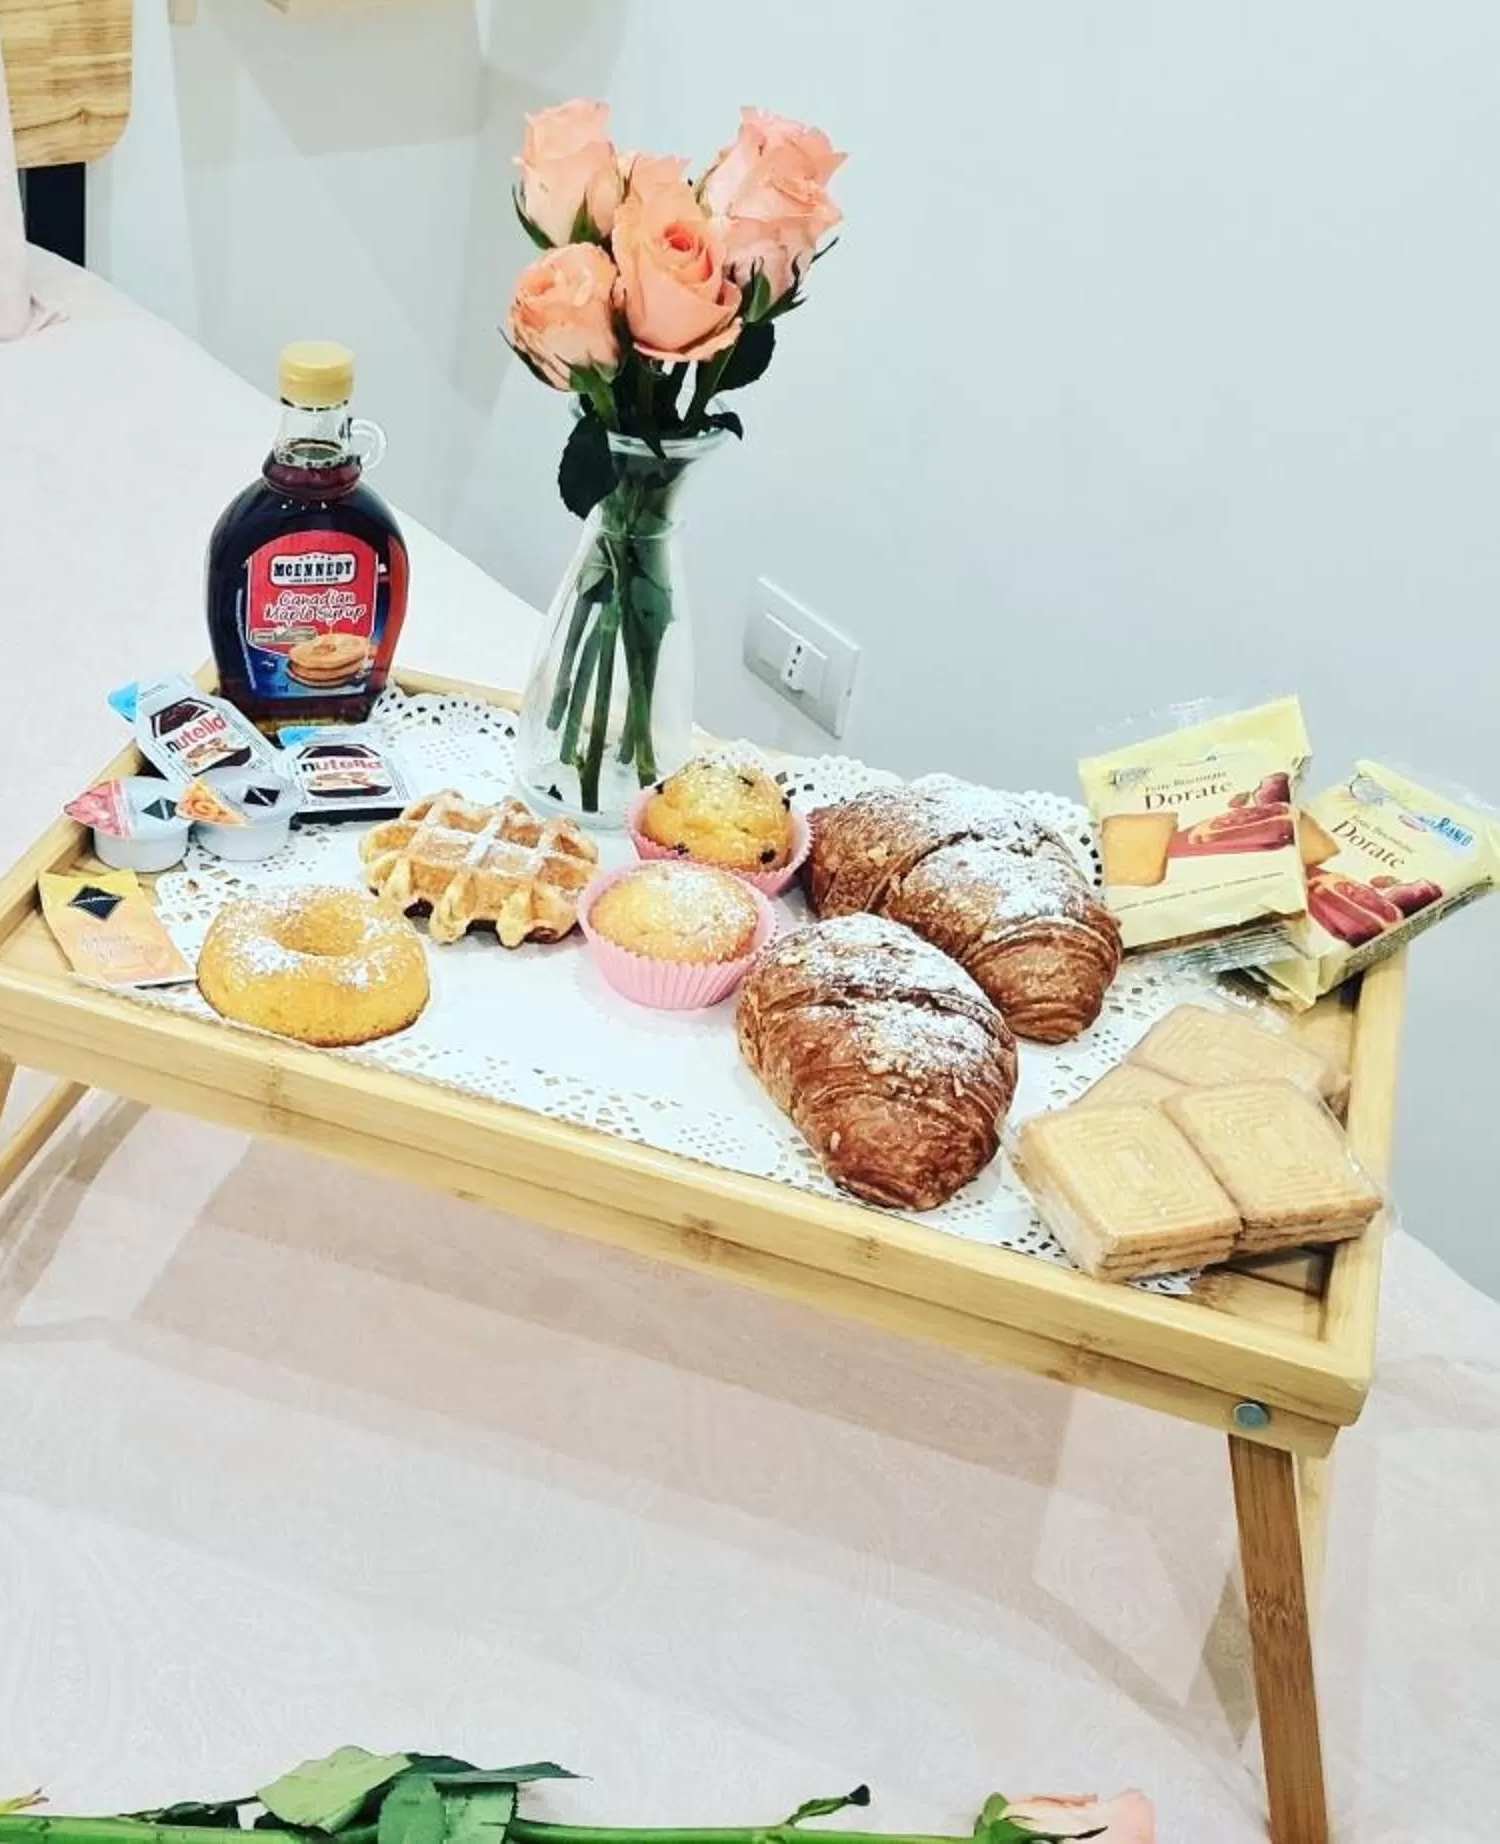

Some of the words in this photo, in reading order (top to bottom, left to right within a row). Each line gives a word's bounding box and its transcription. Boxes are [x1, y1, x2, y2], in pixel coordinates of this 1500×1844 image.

[273, 561, 352, 577] MCENNEDY
[279, 589, 355, 605] Canadian
[316, 604, 366, 624] Syrup
[166, 714, 227, 752] nutella
[302, 759, 383, 771] nutella
[1145, 781, 1232, 809] Dorate
[1331, 819, 1405, 868] Dorate
